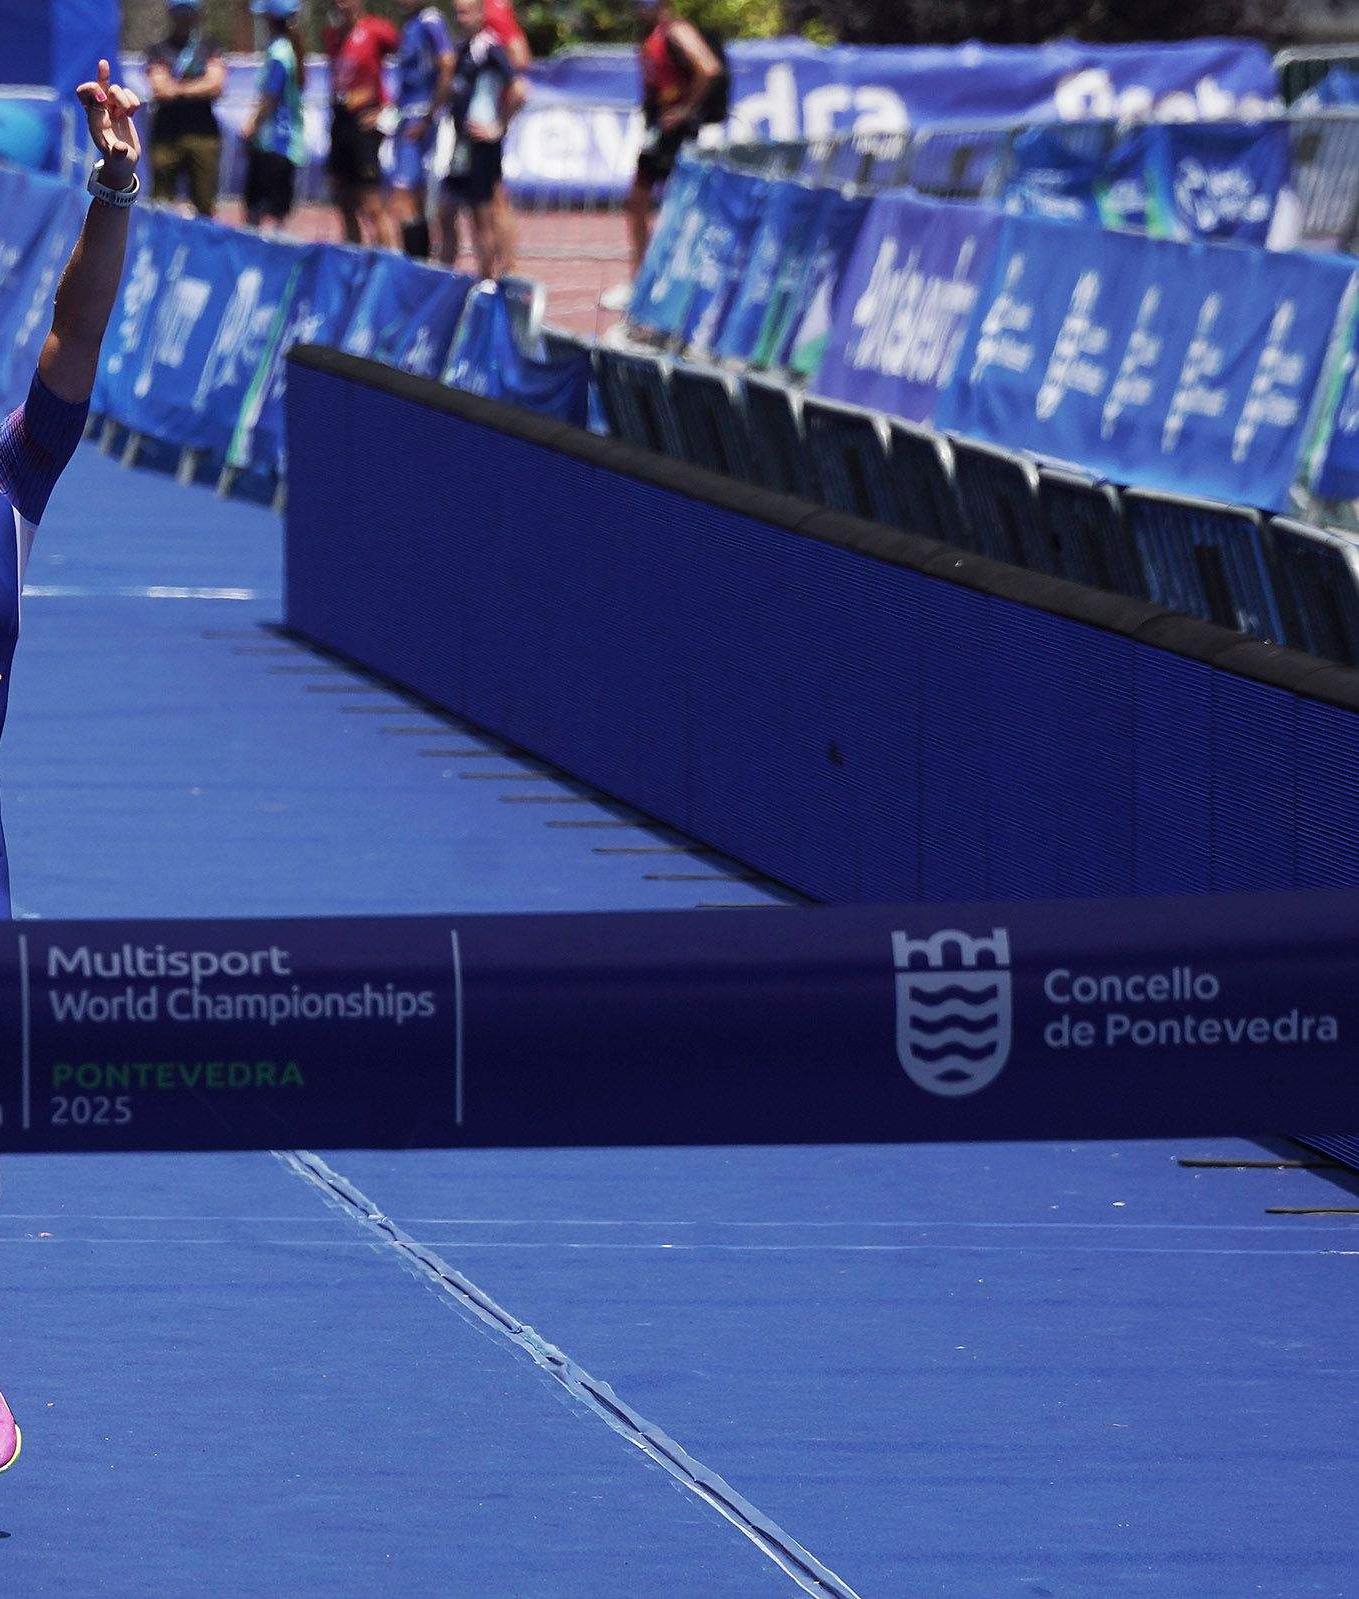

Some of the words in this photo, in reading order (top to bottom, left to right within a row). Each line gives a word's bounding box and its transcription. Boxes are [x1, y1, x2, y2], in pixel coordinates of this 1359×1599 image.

[47, 943, 291, 986] Multisport
[49, 987, 159, 1022] World
[166, 982, 437, 1027] Championships
[1043, 967, 1220, 1004] Concello
[1043, 1015, 1096, 1049] de
[1106, 1008, 1340, 1047] Pontevedra
[51, 1062, 306, 1091] PONTEVEDRA
[51, 1096, 133, 1126] 2025
